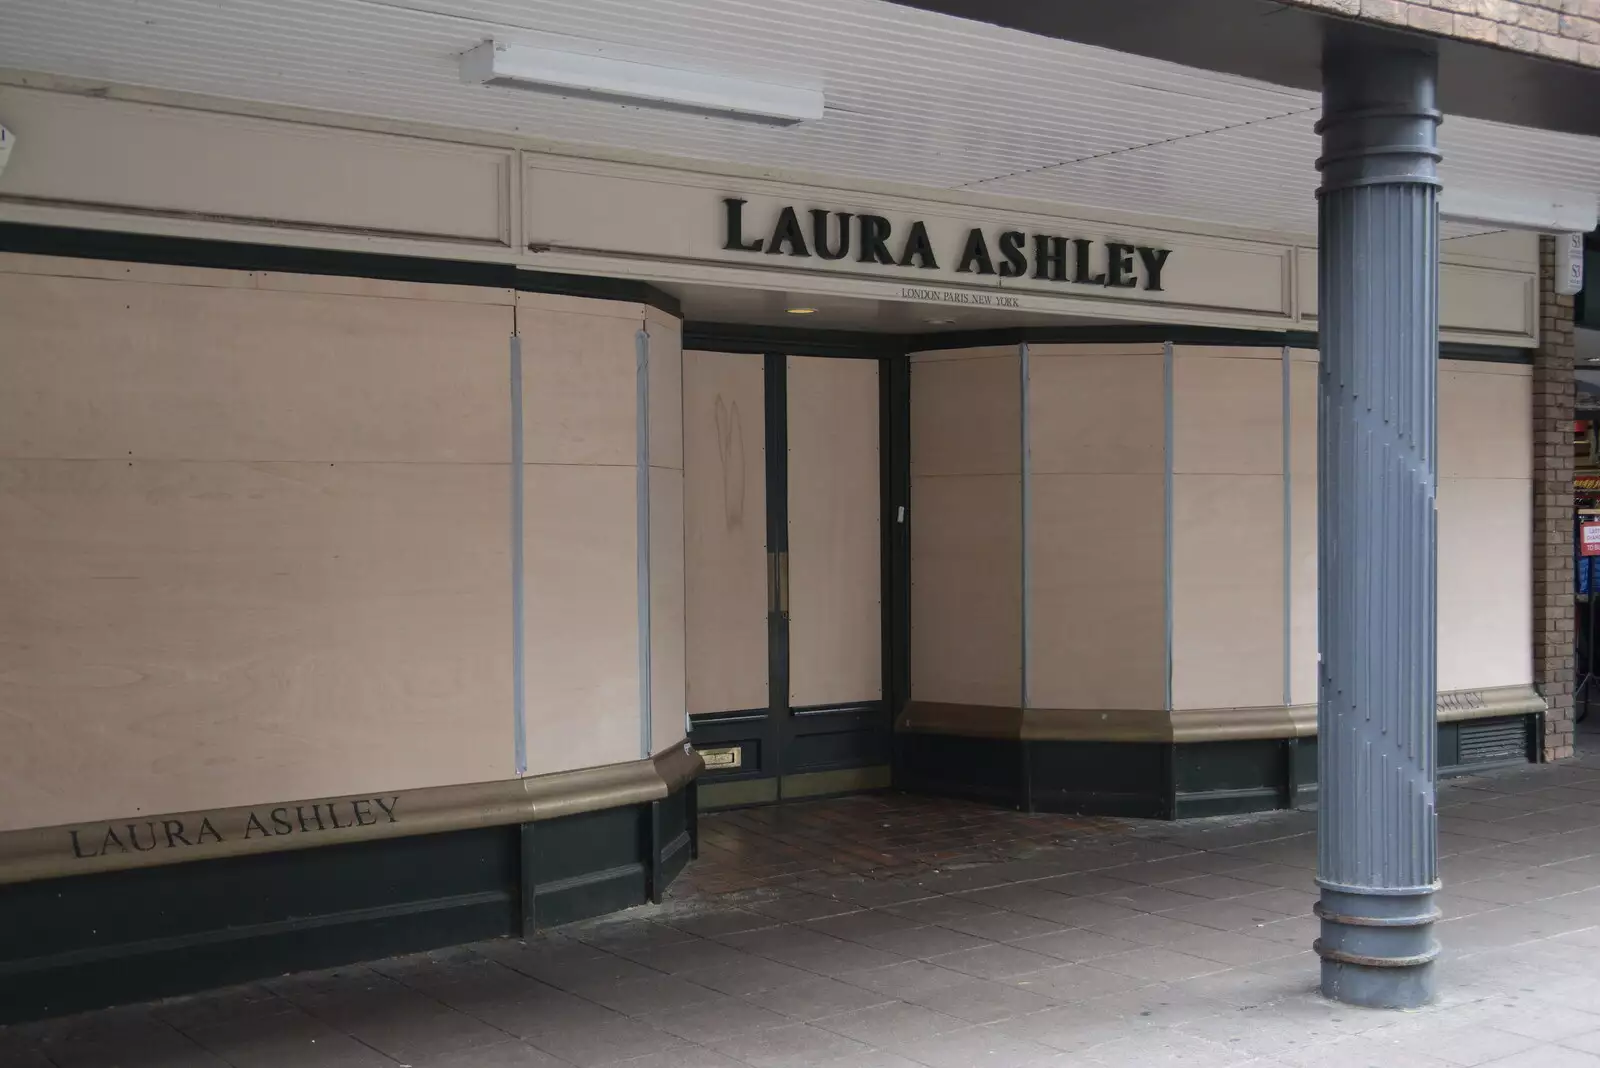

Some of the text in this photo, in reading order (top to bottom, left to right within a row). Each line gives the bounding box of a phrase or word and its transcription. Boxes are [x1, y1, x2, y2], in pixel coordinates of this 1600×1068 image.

[722, 198, 1173, 292] LAURA ASHLEY
[901, 287, 1020, 308] LONDON PARIS NEW YORK
[68, 796, 400, 859] LAURA ASHLEY
